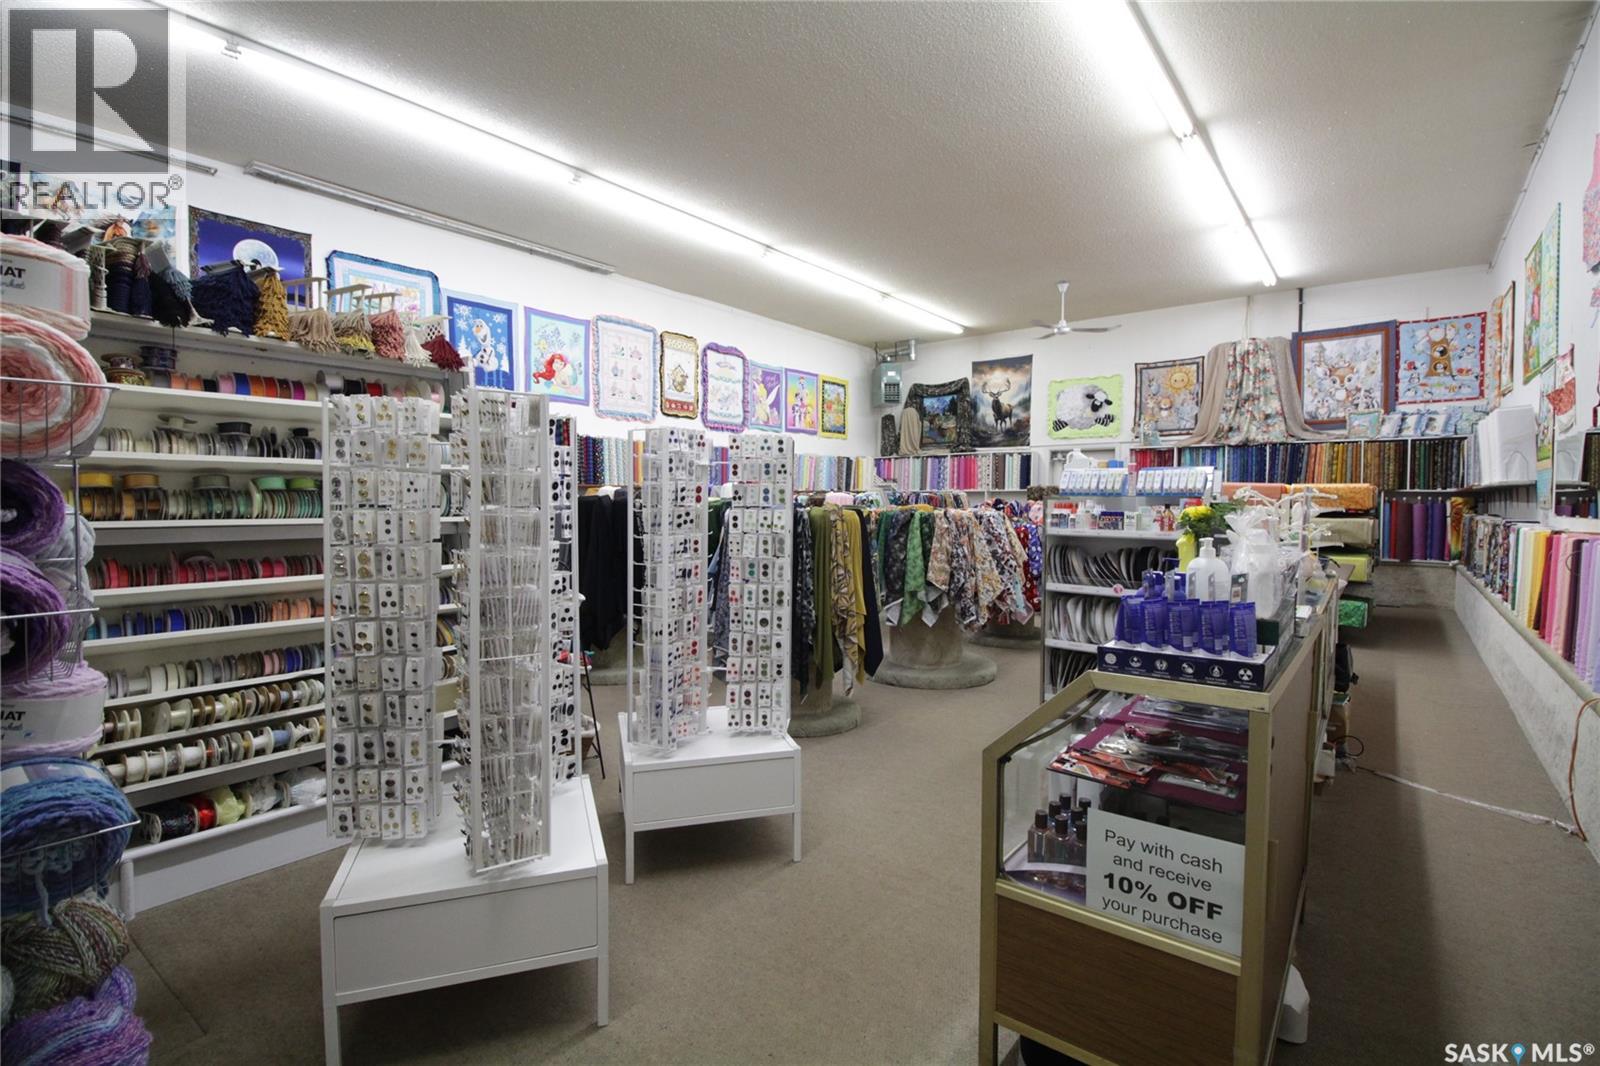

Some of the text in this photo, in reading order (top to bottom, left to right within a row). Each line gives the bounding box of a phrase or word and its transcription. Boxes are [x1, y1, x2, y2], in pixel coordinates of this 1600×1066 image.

[1104, 829, 1223, 874] Pay with cash
[1113, 855, 1212, 891] and receive
[1103, 872, 1223, 919] 10% OFF
[1102, 896, 1223, 943] your purchase
